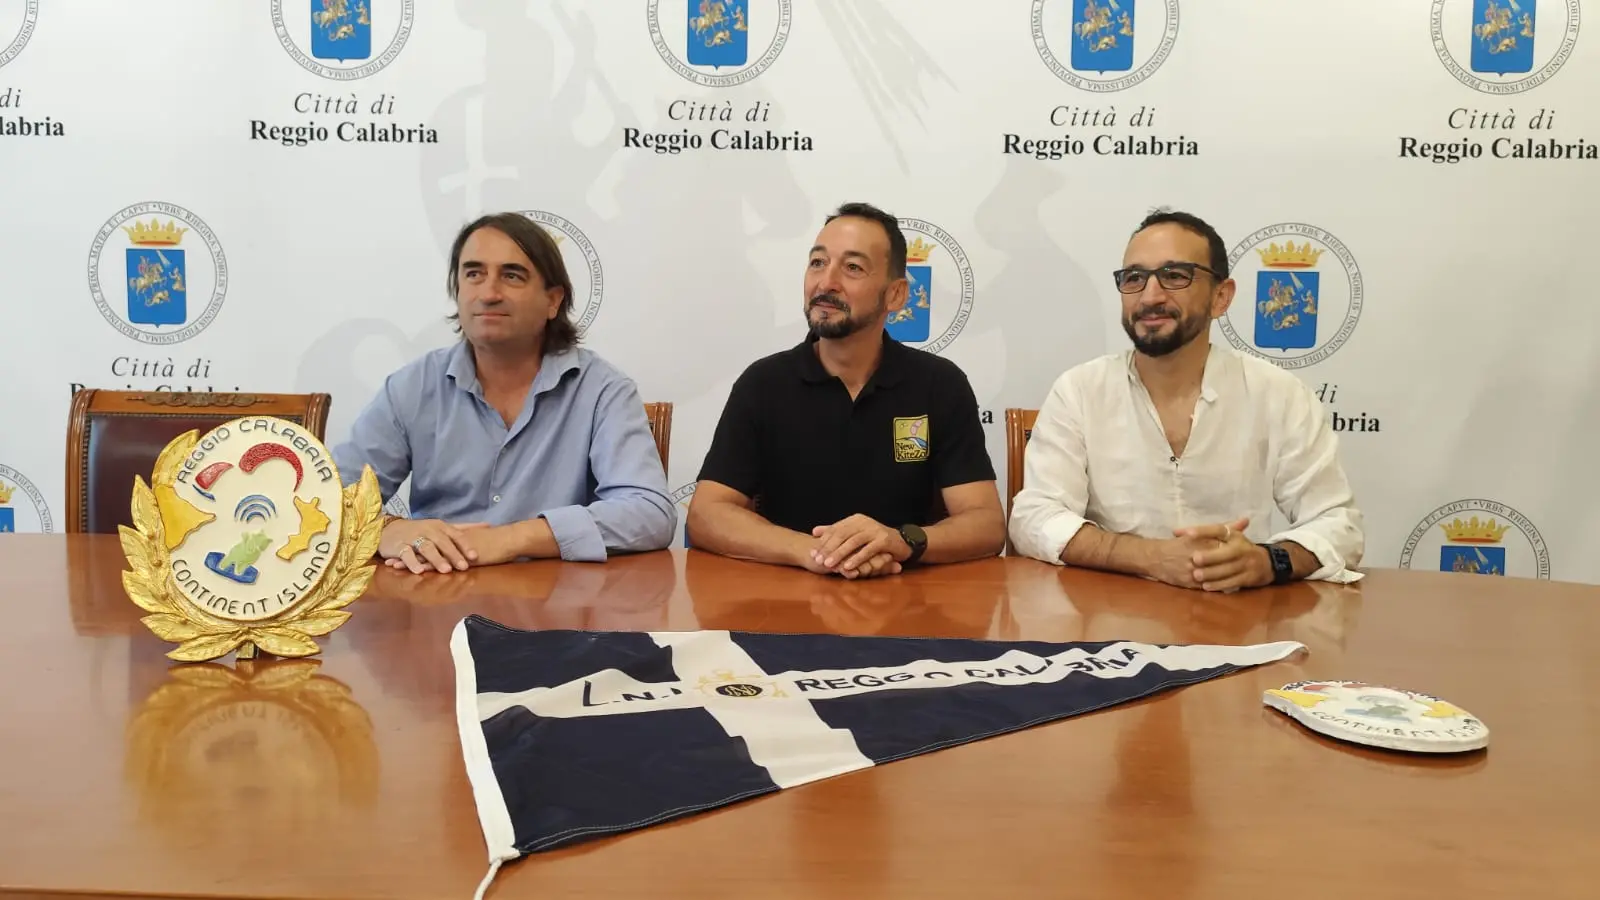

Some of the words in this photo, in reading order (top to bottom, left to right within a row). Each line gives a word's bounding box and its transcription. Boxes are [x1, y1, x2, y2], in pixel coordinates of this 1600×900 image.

[0, 87, 21, 108] di
[294, 92, 358, 114] Città
[370, 94, 395, 115] di
[668, 100, 733, 121] Città
[745, 101, 770, 122] di
[1050, 105, 1117, 127] Città
[1129, 106, 1156, 127] di
[1448, 107, 1516, 130] Città
[1528, 108, 1555, 130] di
[0, 116, 65, 136] labria
[249, 120, 328, 147] Reggio
[336, 121, 438, 143] Calabria
[623, 127, 702, 154] Reggio
[710, 129, 813, 151] Calabria
[1003, 134, 1084, 160] Reggio
[1093, 135, 1199, 156] Calabria
[1399, 137, 1483, 164] Reggio
[1491, 138, 1599, 159] Calabria
[579, 301, 600, 329] INSIGN
[111, 356, 175, 378] Città
[187, 357, 211, 379] di
[1315, 383, 1338, 403] di
[1332, 412, 1380, 432] bria
[177, 426, 231, 484] REGGIO
[239, 419, 333, 484] CALABRIA
[172, 558, 268, 615] CONTINENT
[277, 541, 331, 605] ISLAND
[794, 671, 953, 692] REGGO
[964, 648, 1142, 678] CALBRIA
